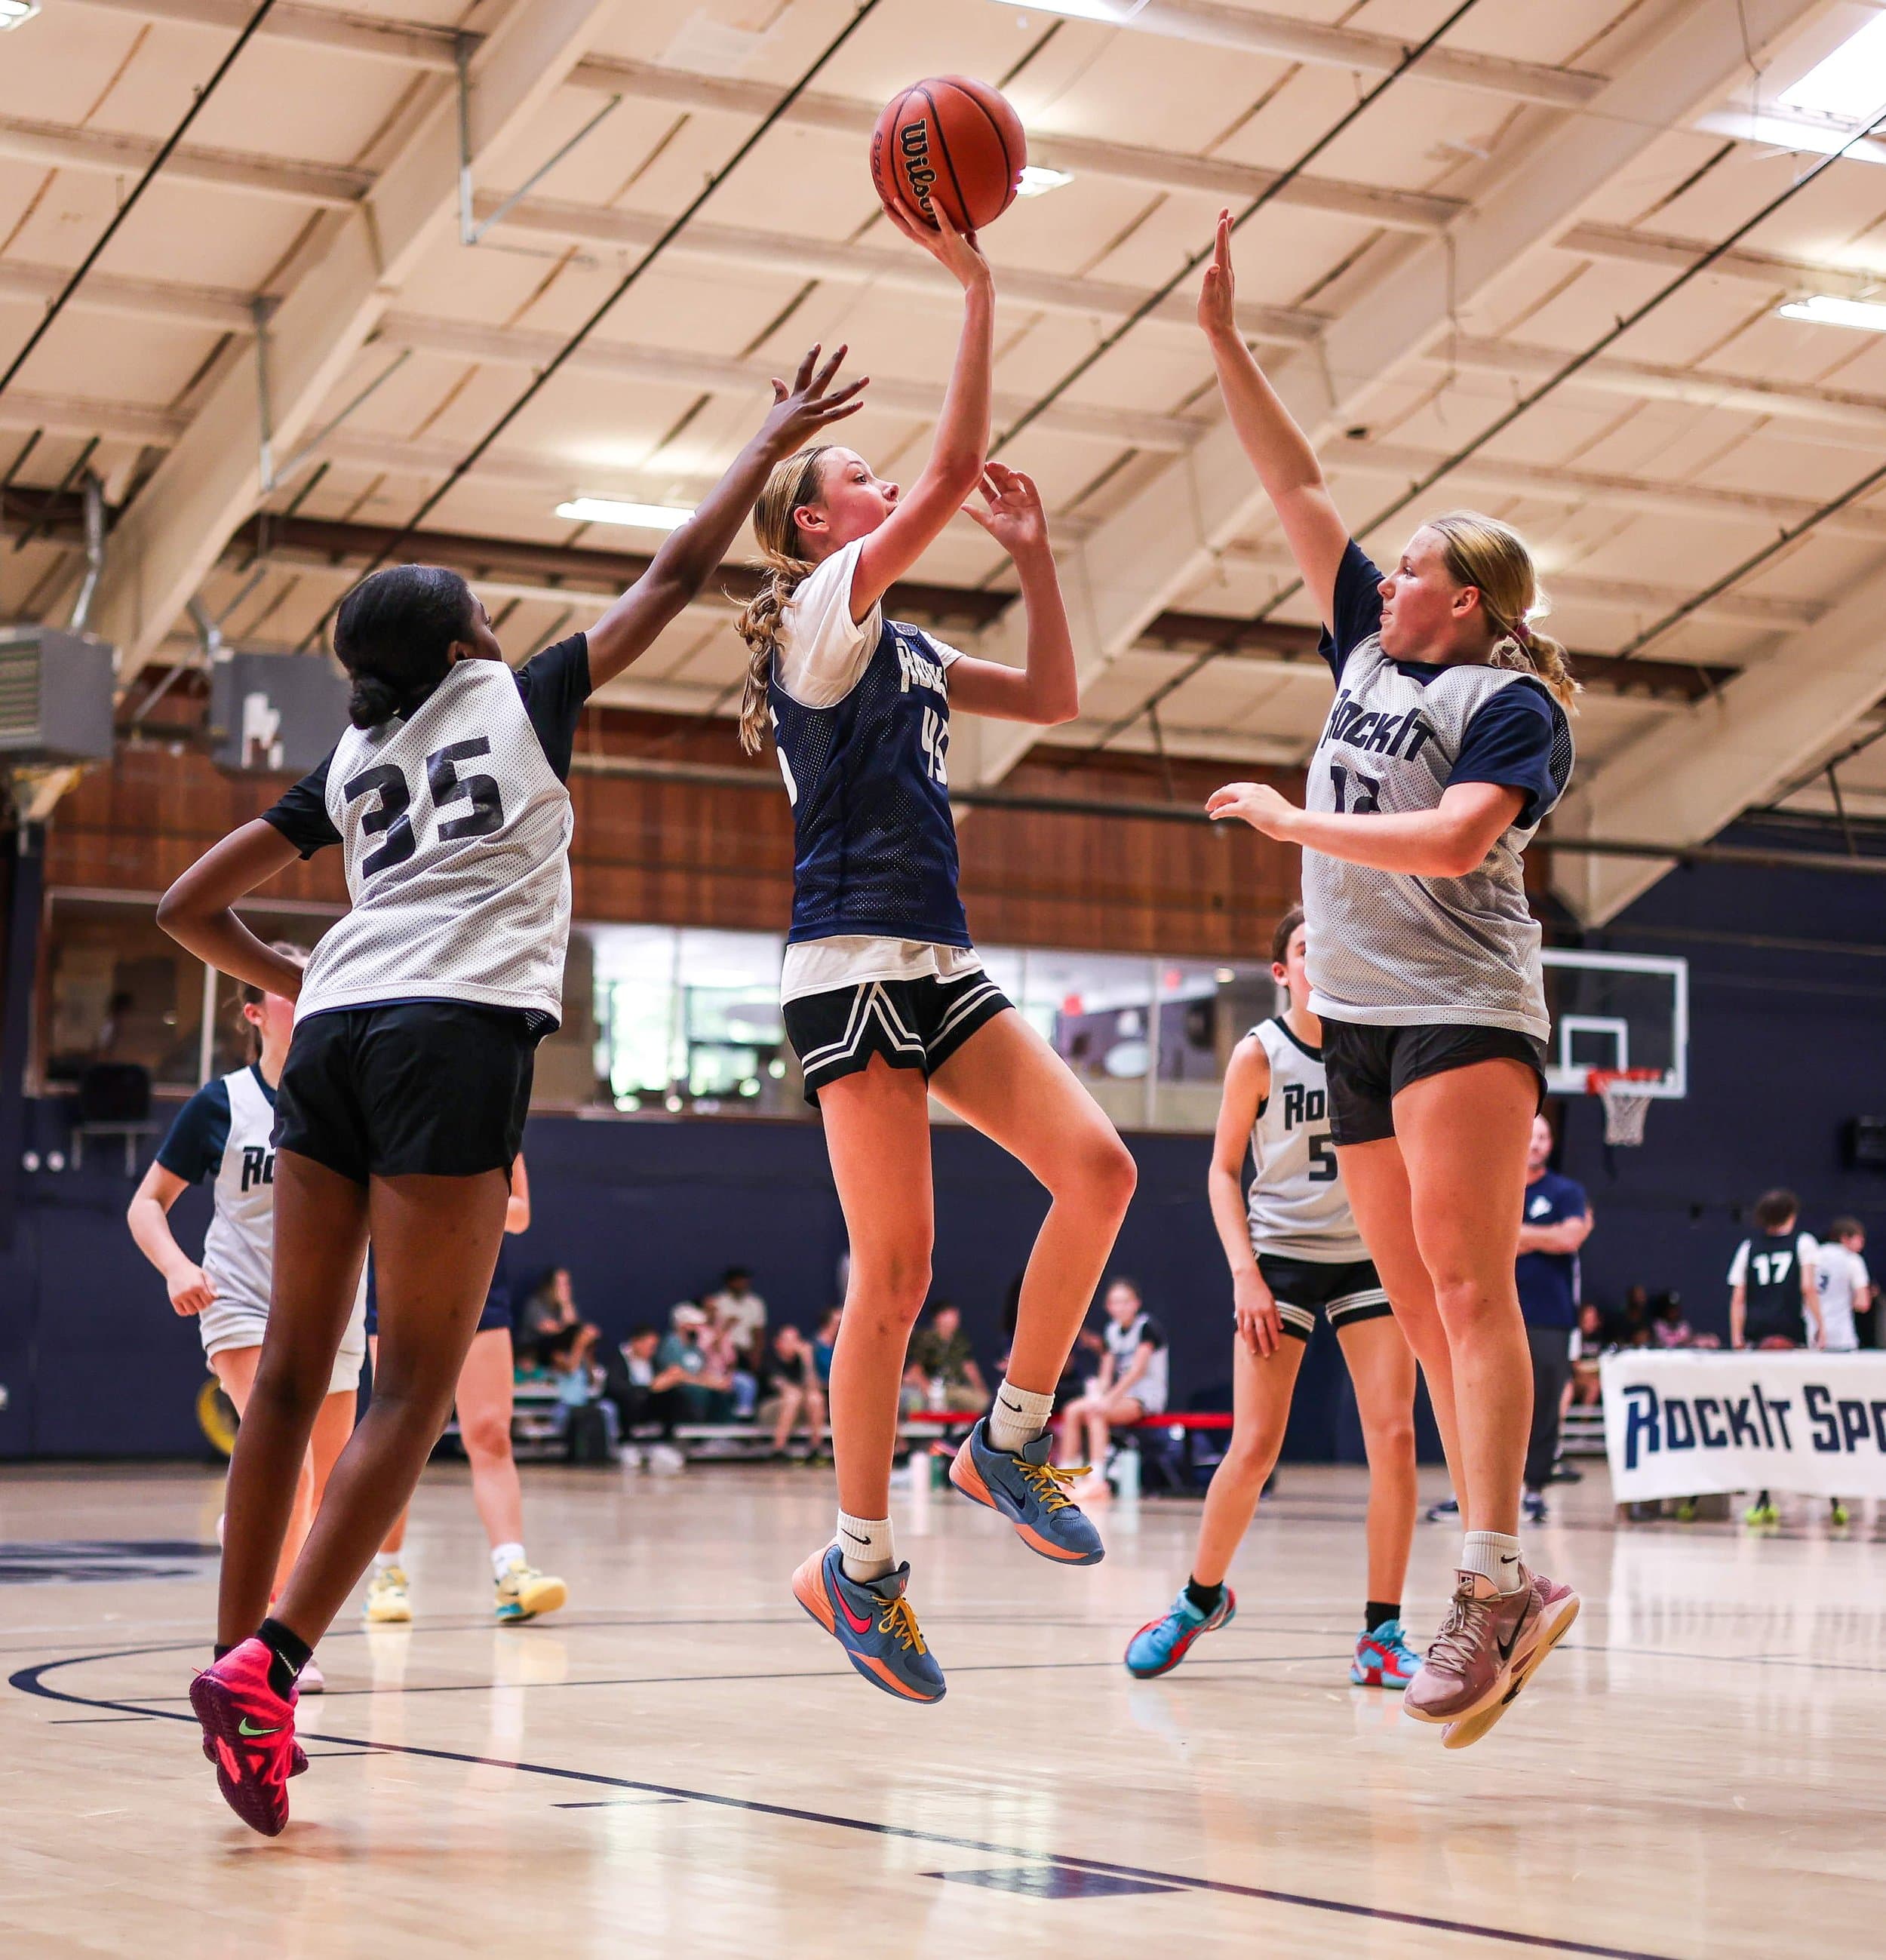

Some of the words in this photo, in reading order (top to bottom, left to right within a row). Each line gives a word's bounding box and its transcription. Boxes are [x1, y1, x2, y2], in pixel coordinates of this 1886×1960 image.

[343, 736, 504, 880] 35
[1282, 1083, 1330, 1130] RO
[1309, 1133, 1338, 1181] 5
[1752, 1250, 1794, 1286] 17
